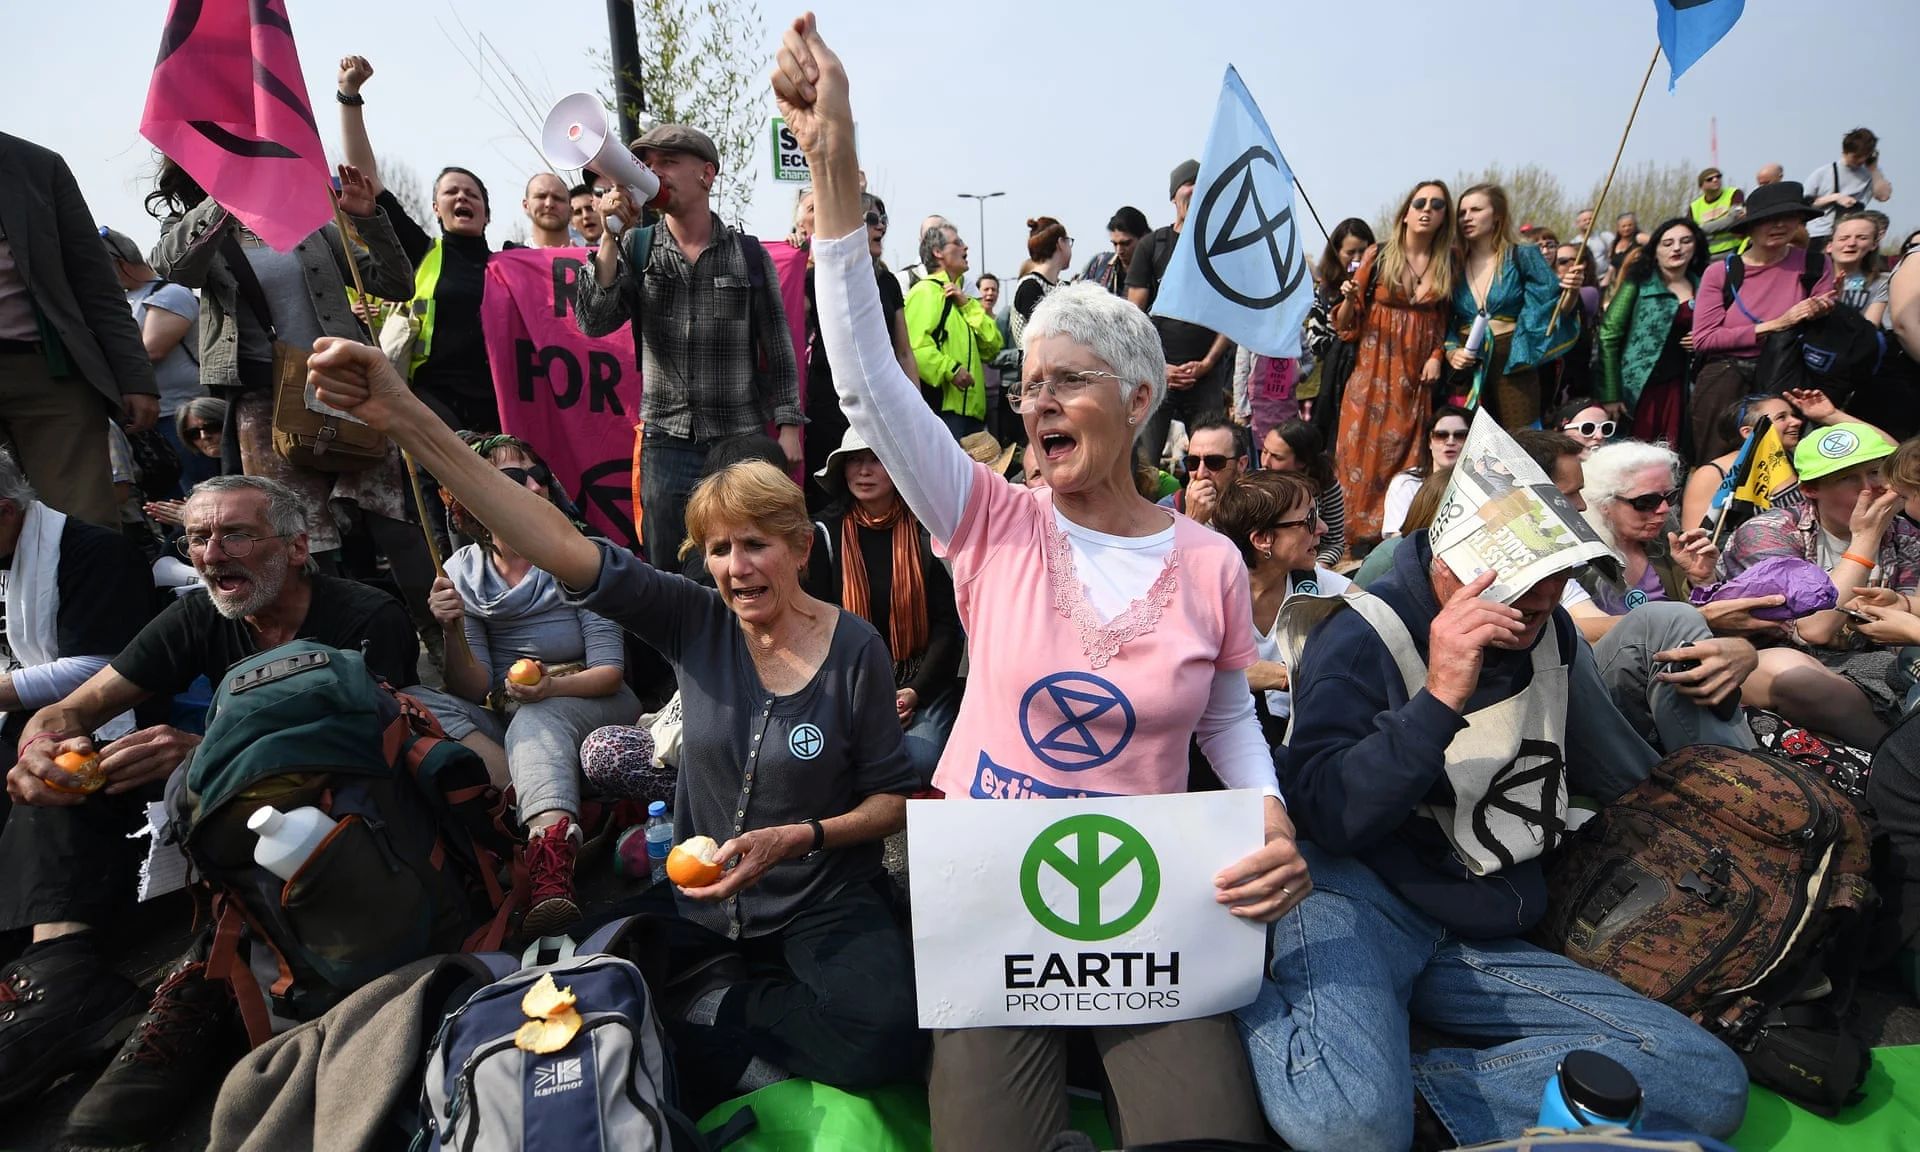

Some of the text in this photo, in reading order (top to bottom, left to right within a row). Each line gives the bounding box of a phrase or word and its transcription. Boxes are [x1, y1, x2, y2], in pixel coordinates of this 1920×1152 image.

[779, 169, 811, 182] chang
[515, 338, 626, 417] FOR
[1267, 383, 1285, 392] LIFE
[1481, 544, 1519, 581] PASS
[1004, 951, 1180, 989] EARTH
[1005, 990, 1181, 1013] PROTECTORS
[534, 1080, 584, 1097] karrimor
